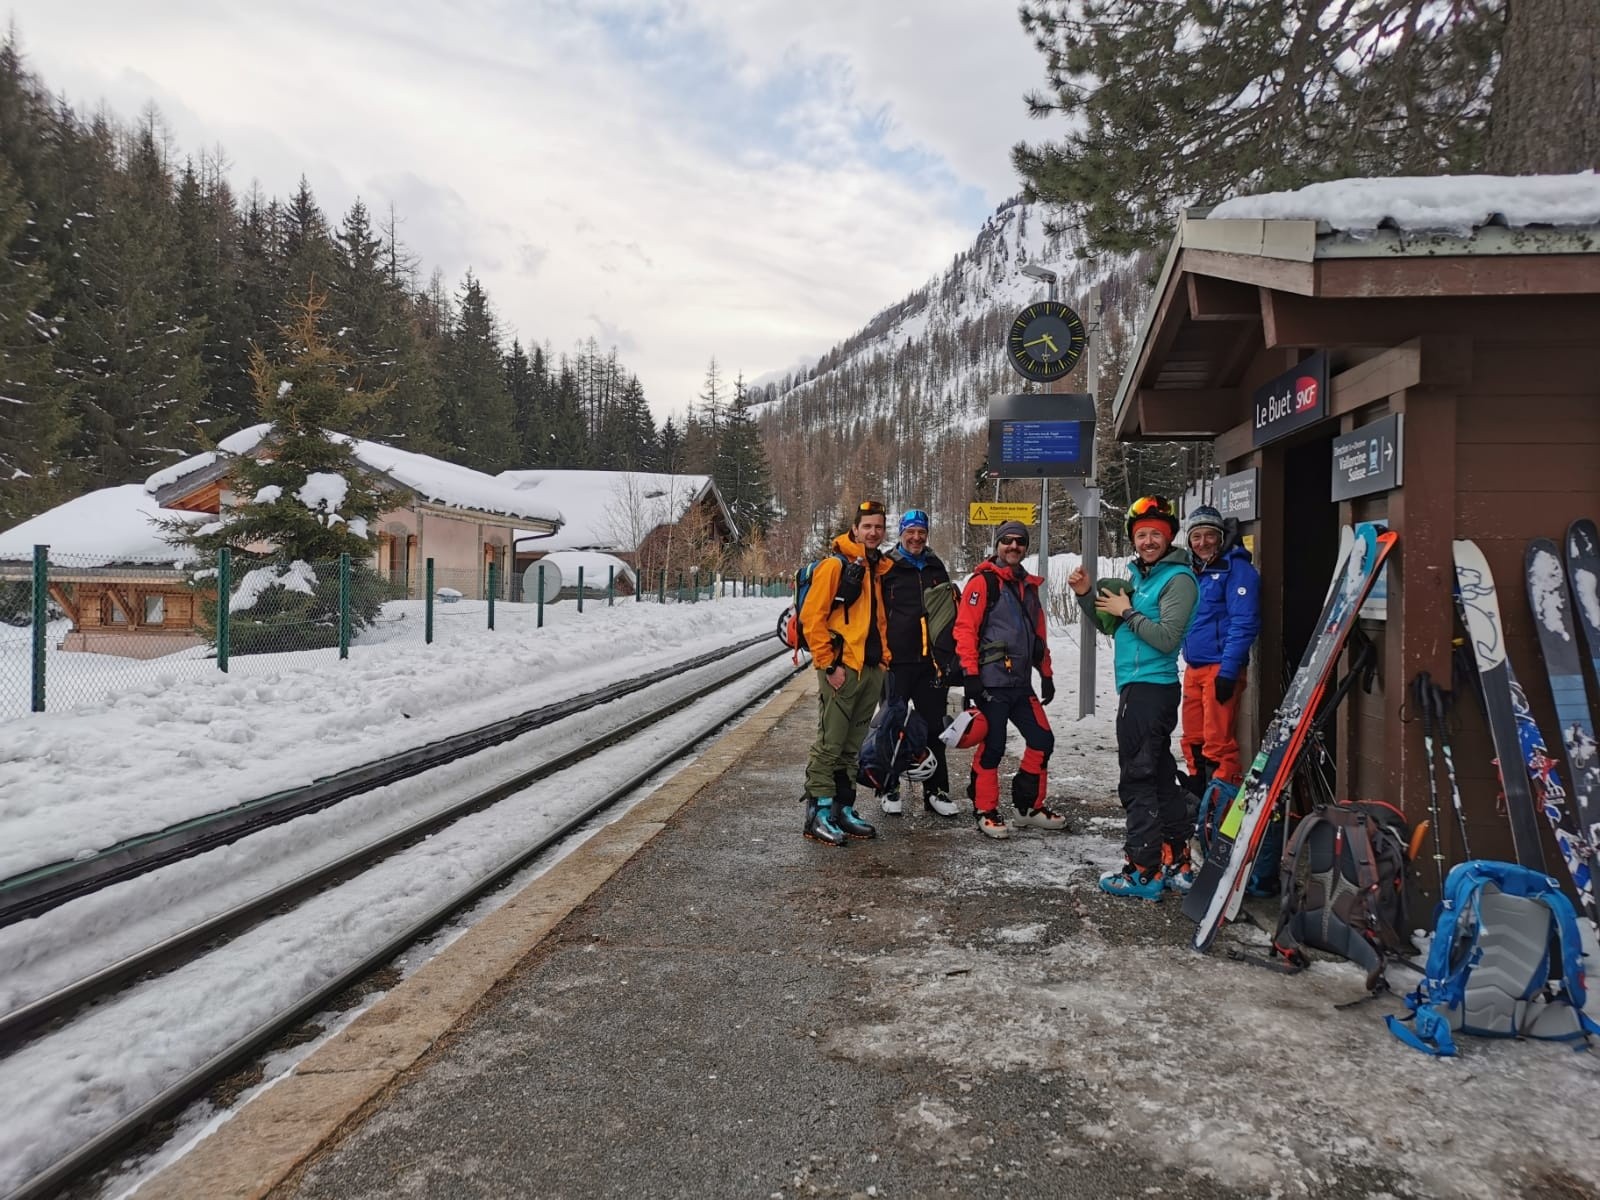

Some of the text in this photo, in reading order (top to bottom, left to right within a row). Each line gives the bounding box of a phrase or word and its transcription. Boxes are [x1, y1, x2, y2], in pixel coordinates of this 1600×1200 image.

[1295, 384, 1317, 409] SNCF
[1256, 389, 1292, 429] Le Buet
[1339, 451, 1367, 470] Vallorcine
[1348, 467, 1367, 482] Suisse
[1229, 498, 1250, 512] St-Gervais
